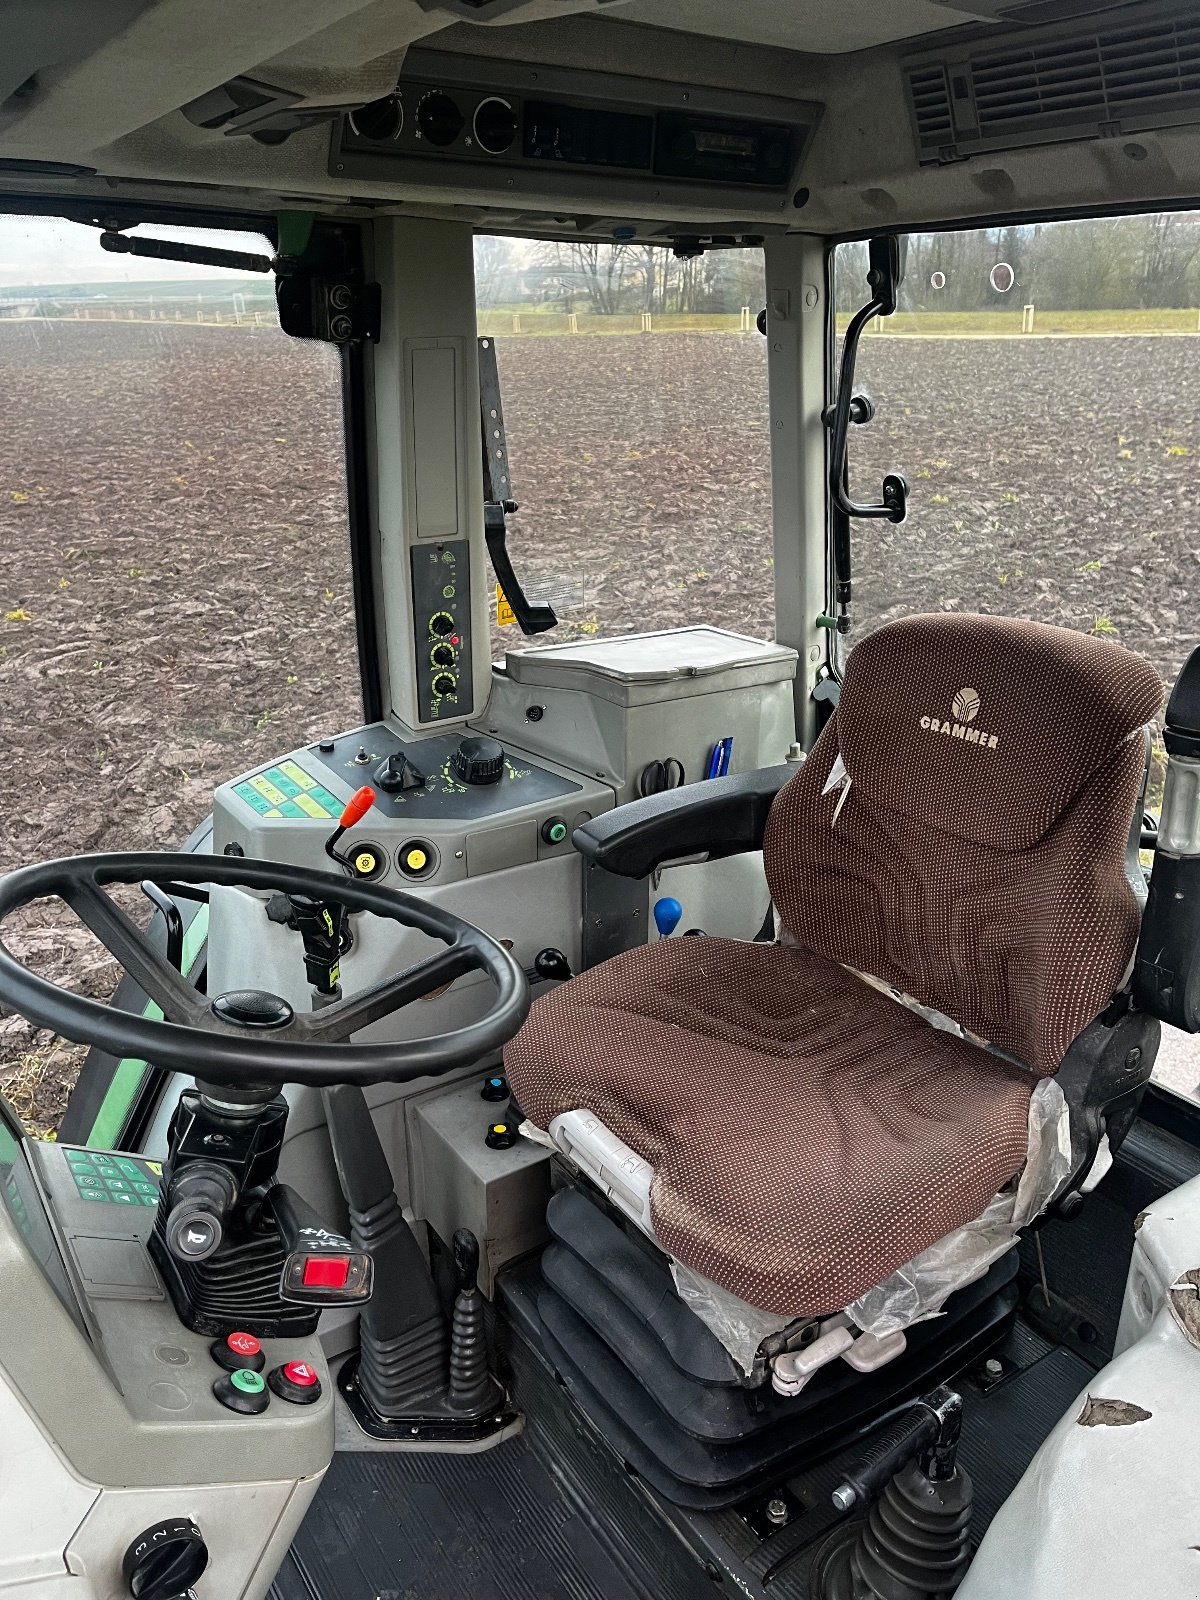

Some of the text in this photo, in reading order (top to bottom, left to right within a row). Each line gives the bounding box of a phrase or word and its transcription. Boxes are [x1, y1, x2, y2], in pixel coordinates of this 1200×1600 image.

[920, 715, 999, 749] GRAMMER
[135, 1542, 147, 1556] 3
[152, 1529, 167, 1541] 2
